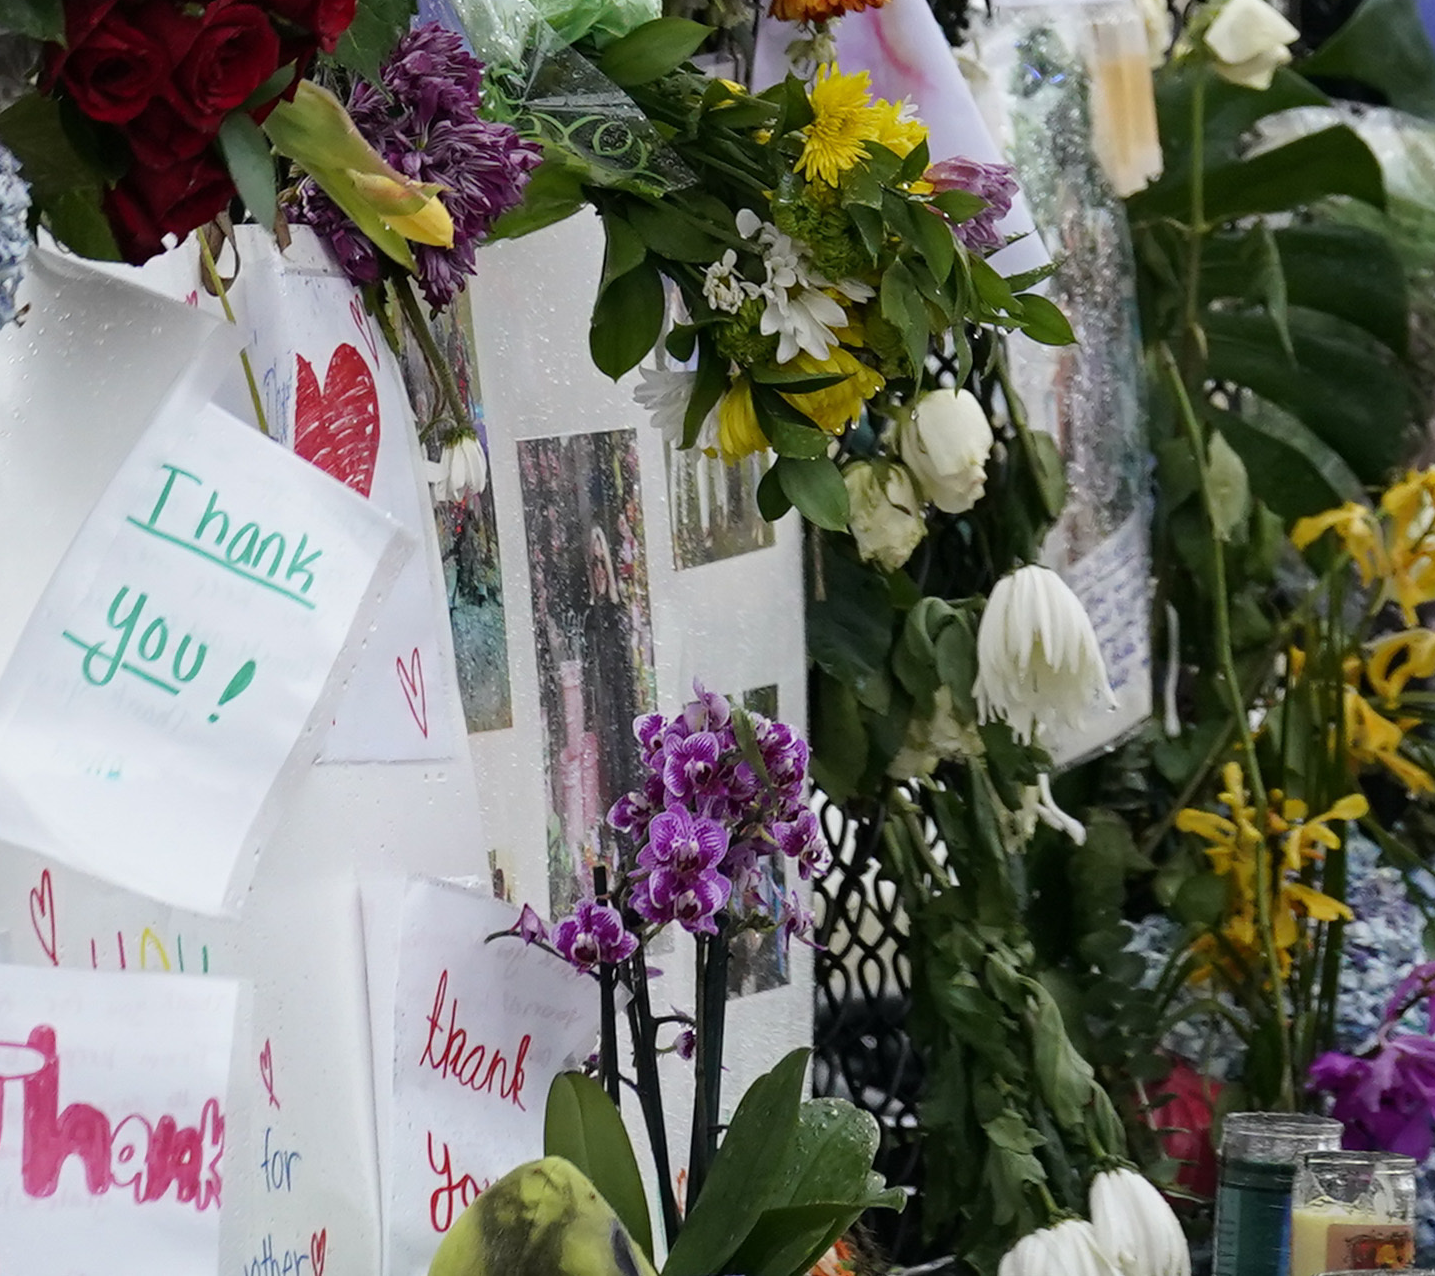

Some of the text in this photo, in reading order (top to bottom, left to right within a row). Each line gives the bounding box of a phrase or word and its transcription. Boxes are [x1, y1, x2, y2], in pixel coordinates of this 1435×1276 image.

[148, 462, 323, 593] Thank
[419, 969, 532, 1112] thank
[261, 1127, 302, 1193] for
